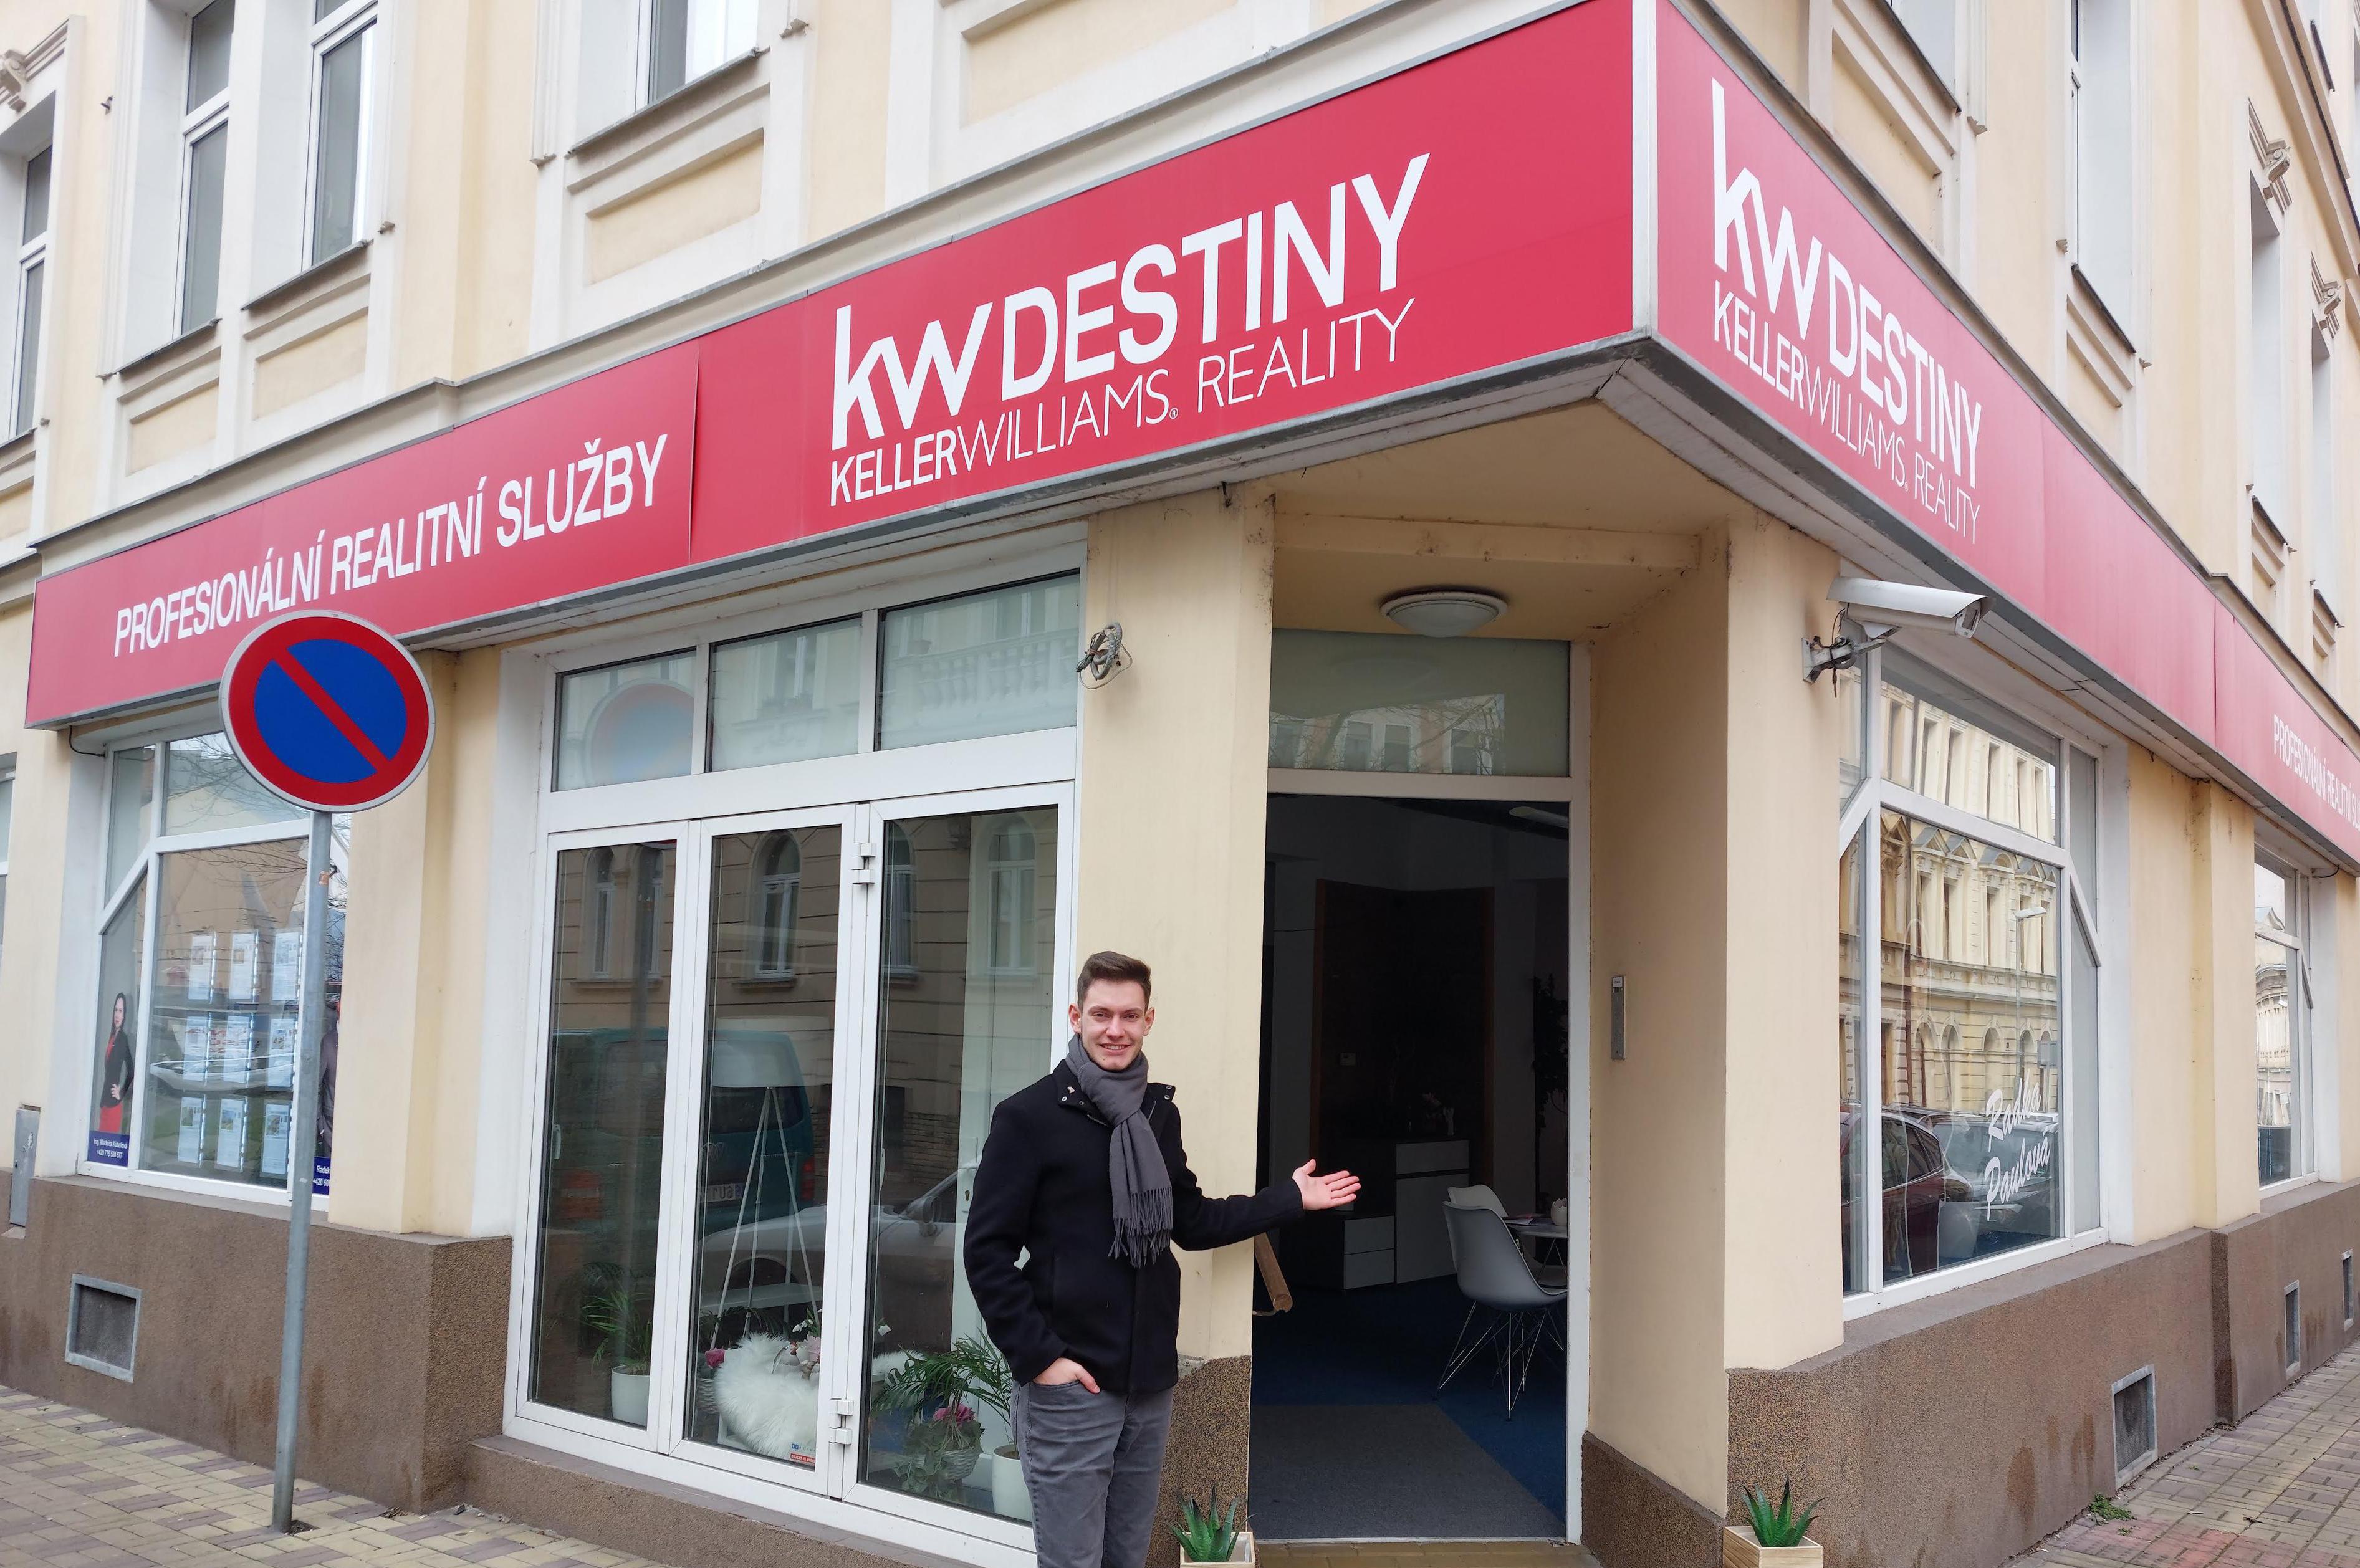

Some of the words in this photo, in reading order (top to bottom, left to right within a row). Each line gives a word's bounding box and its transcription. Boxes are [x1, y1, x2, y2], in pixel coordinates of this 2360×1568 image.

[1002, 153, 1431, 401] DESTINY
[1197, 298, 1415, 413] REALITY
[1829, 252, 1982, 489] DESTINY
[115, 530, 325, 657] PROFESIONÁLNÍ
[330, 476, 487, 595] REALITNÍ
[496, 434, 668, 548] SLUŽBY
[1914, 452, 1980, 544] REALITY
[1987, 1068, 2041, 1153] Radka
